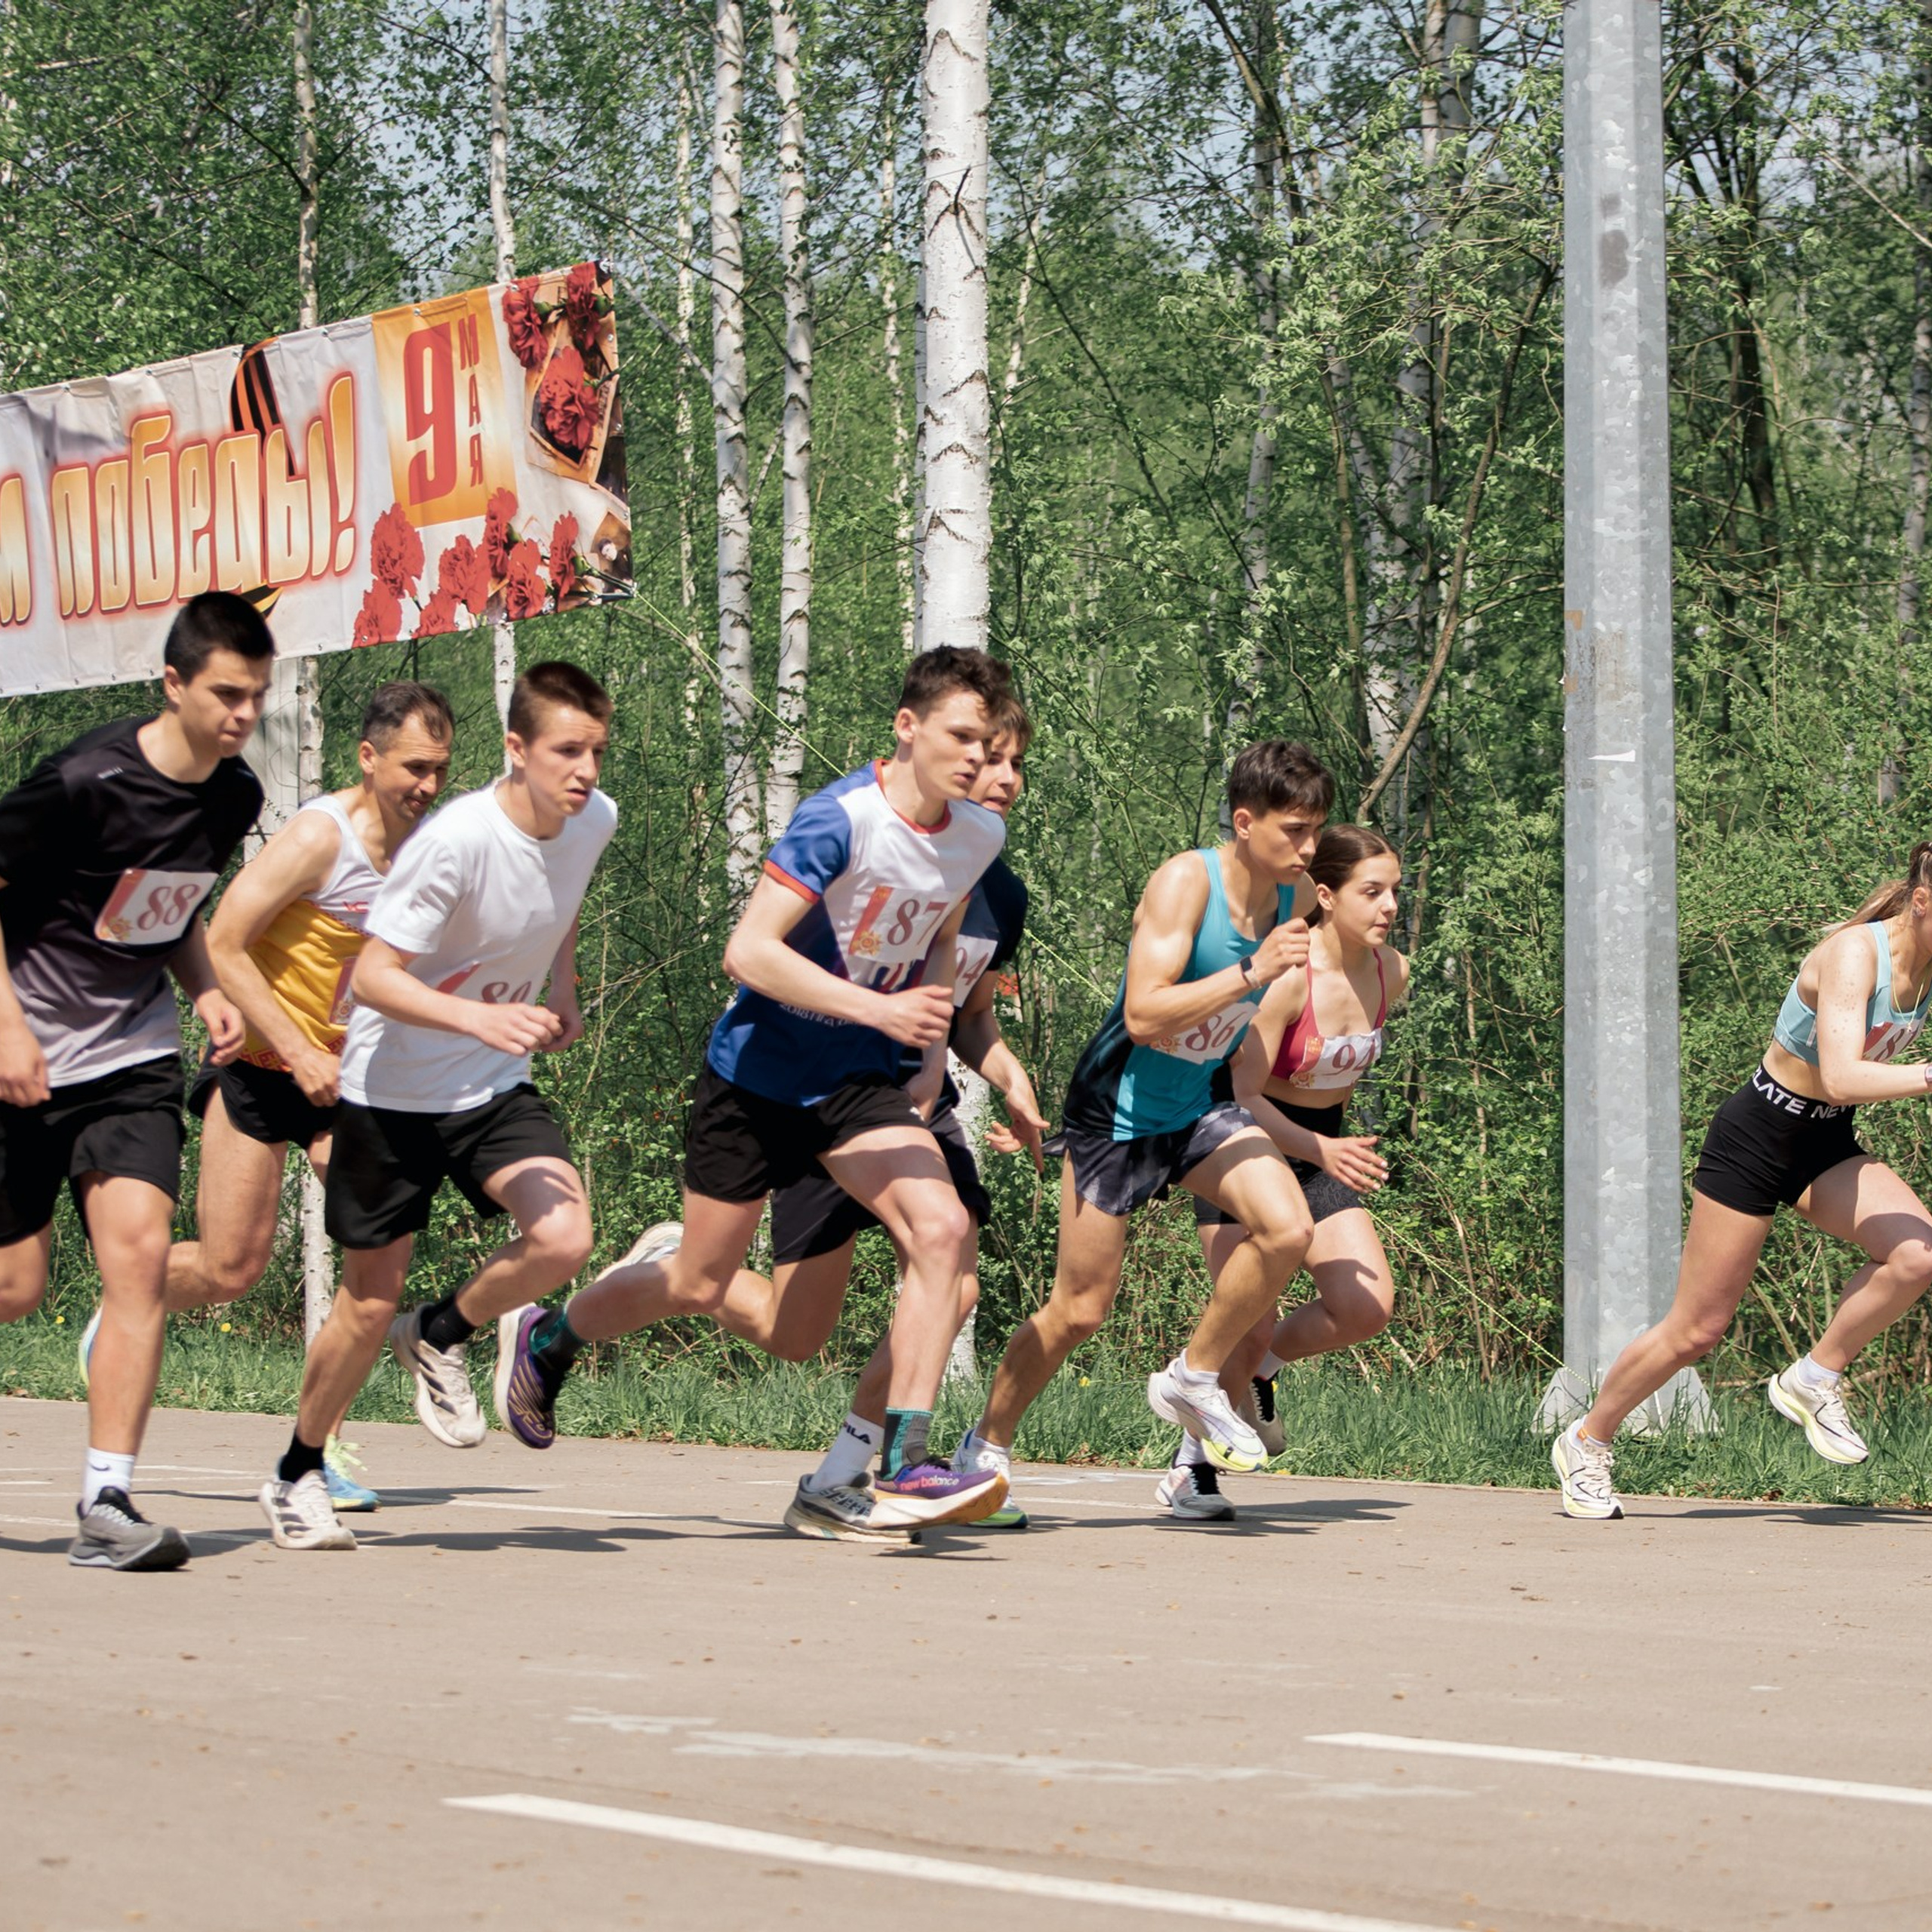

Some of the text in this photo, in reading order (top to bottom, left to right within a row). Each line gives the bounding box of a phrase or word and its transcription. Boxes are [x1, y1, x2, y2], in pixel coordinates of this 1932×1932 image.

[404, 313, 484, 506] 9 МАЯ
[137, 883, 202, 931] 88
[887, 898, 948, 946] 87
[1185, 1013, 1247, 1052] 86
[899, 1475, 961, 1491] new balance
